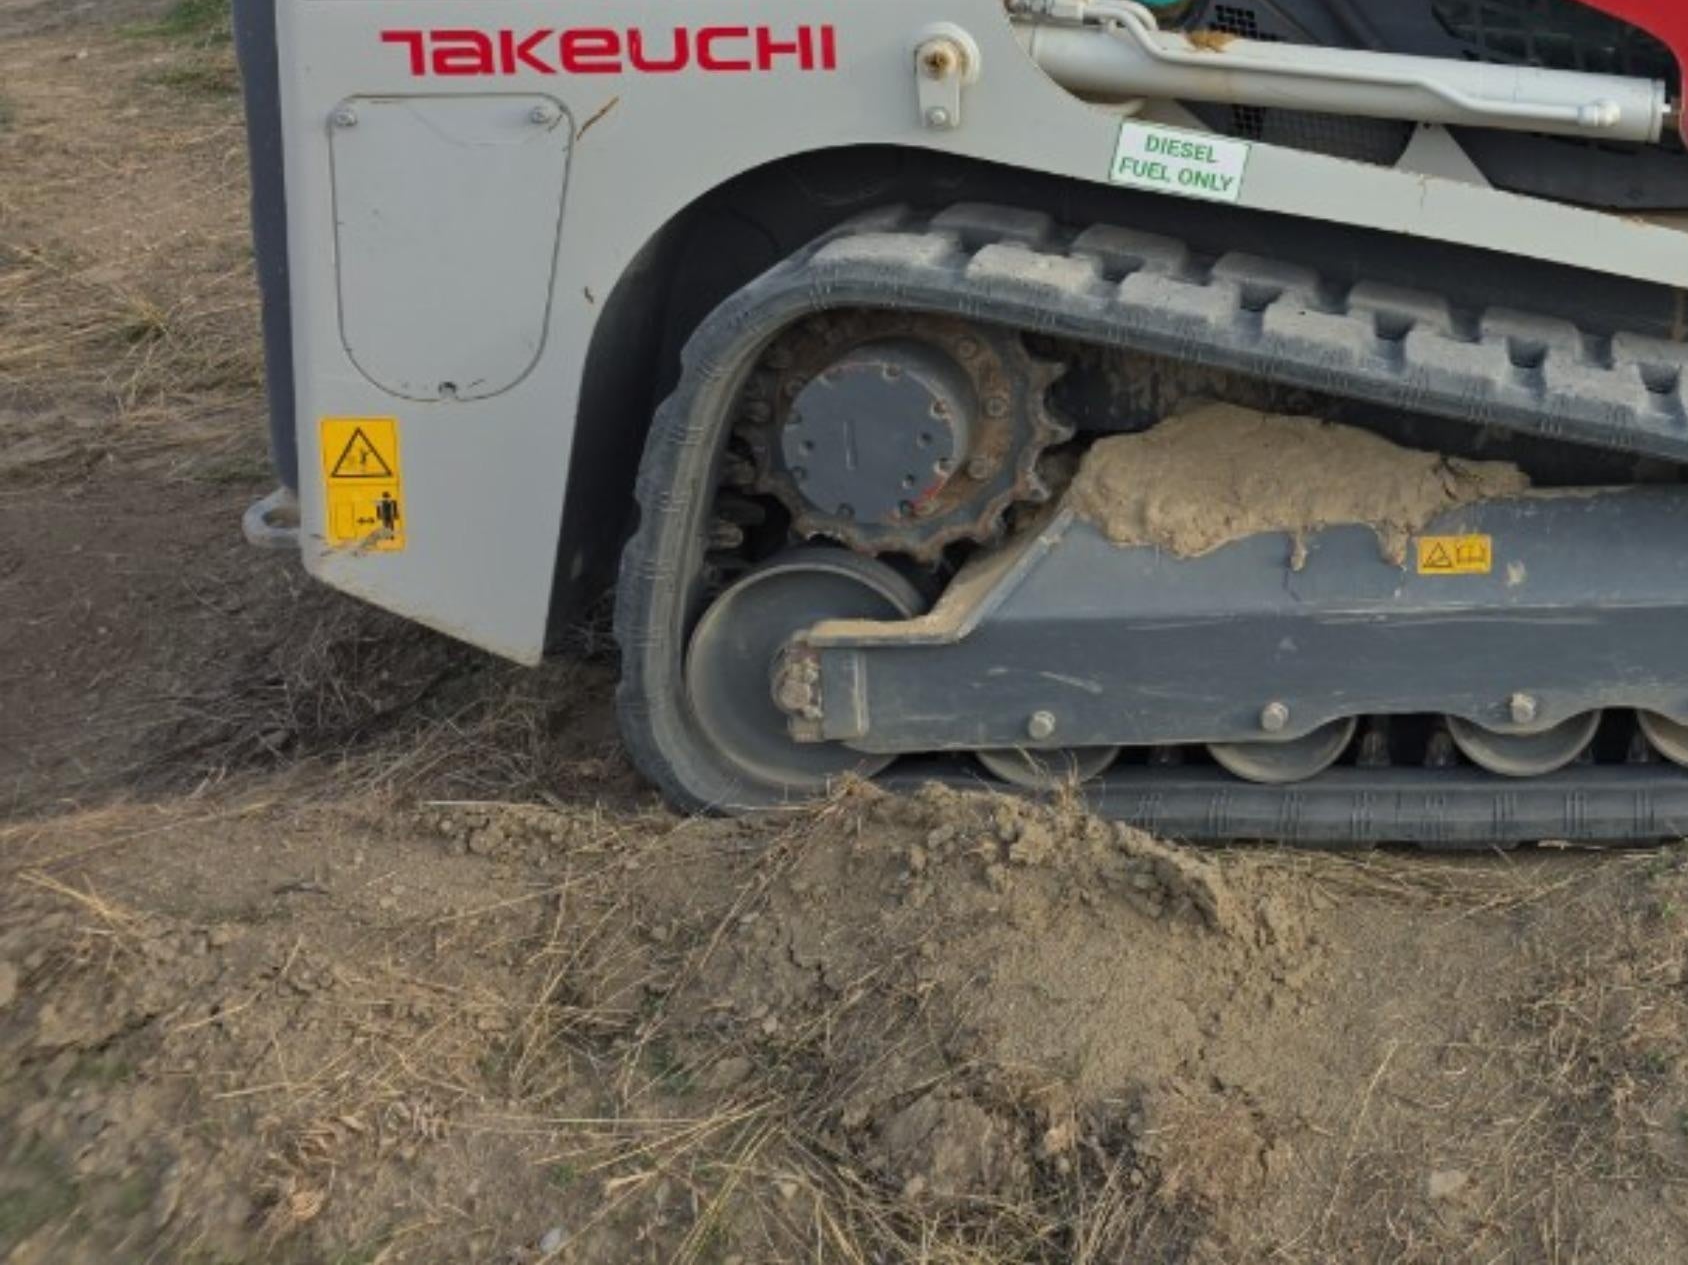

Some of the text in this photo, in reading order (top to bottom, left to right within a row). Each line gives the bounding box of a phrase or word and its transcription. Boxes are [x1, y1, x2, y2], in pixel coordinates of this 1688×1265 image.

[1145, 134, 1217, 163] DIESEL
[1119, 157, 1234, 191] FUEL ONLY
